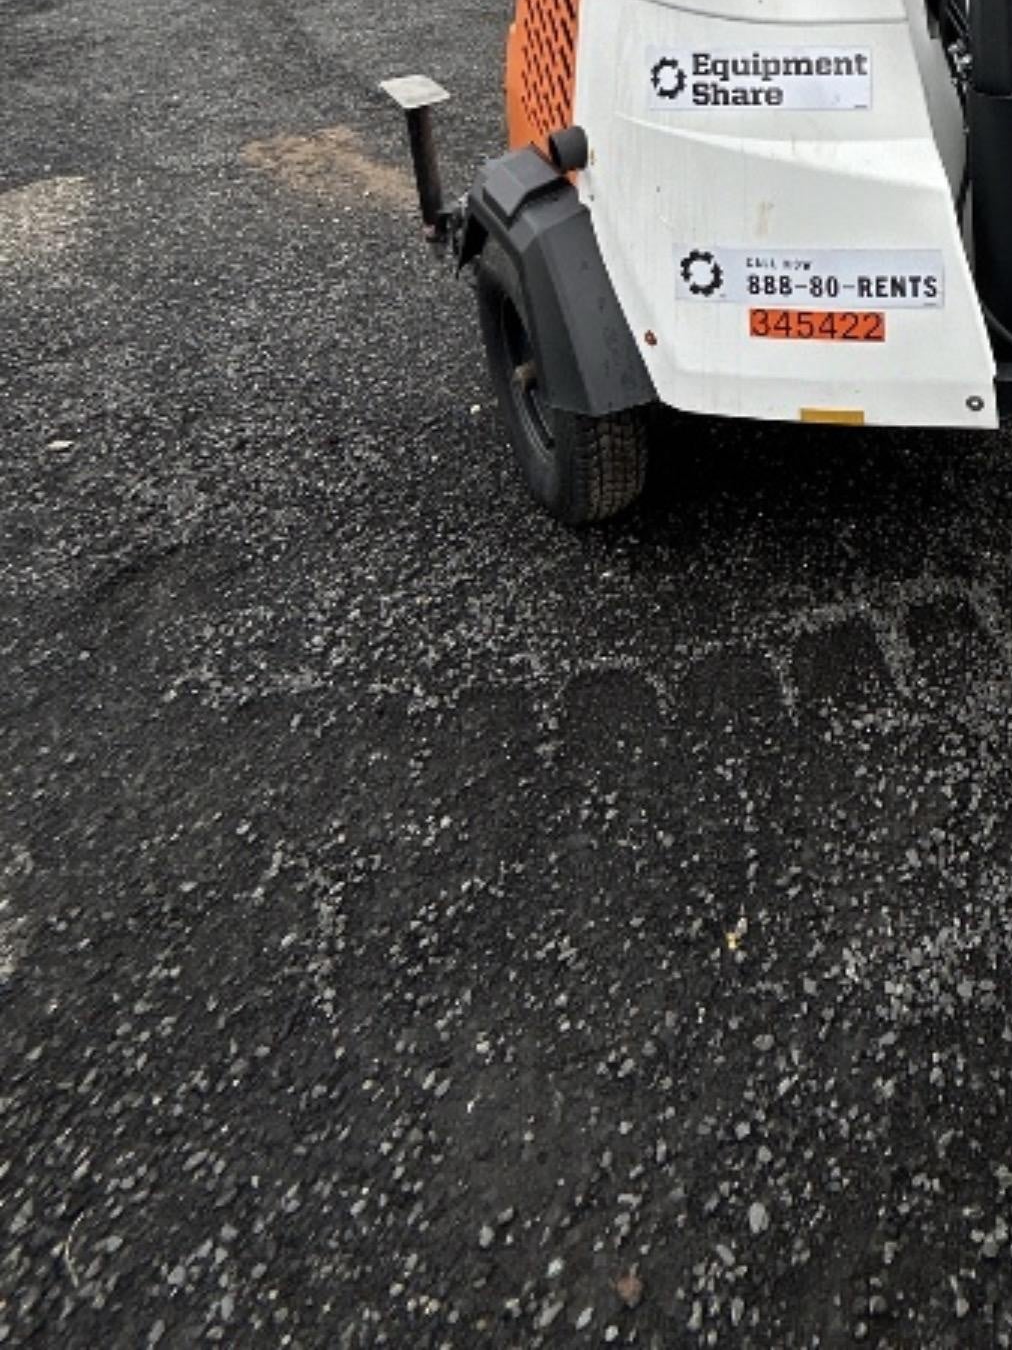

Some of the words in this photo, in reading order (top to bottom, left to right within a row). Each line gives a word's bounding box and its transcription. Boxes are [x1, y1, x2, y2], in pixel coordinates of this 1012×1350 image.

[691, 52, 869, 82] Equipment
[691, 82, 784, 107] Share
[748, 274, 938, 299] 888-80-RENTS
[750, 308, 884, 340] 345422
